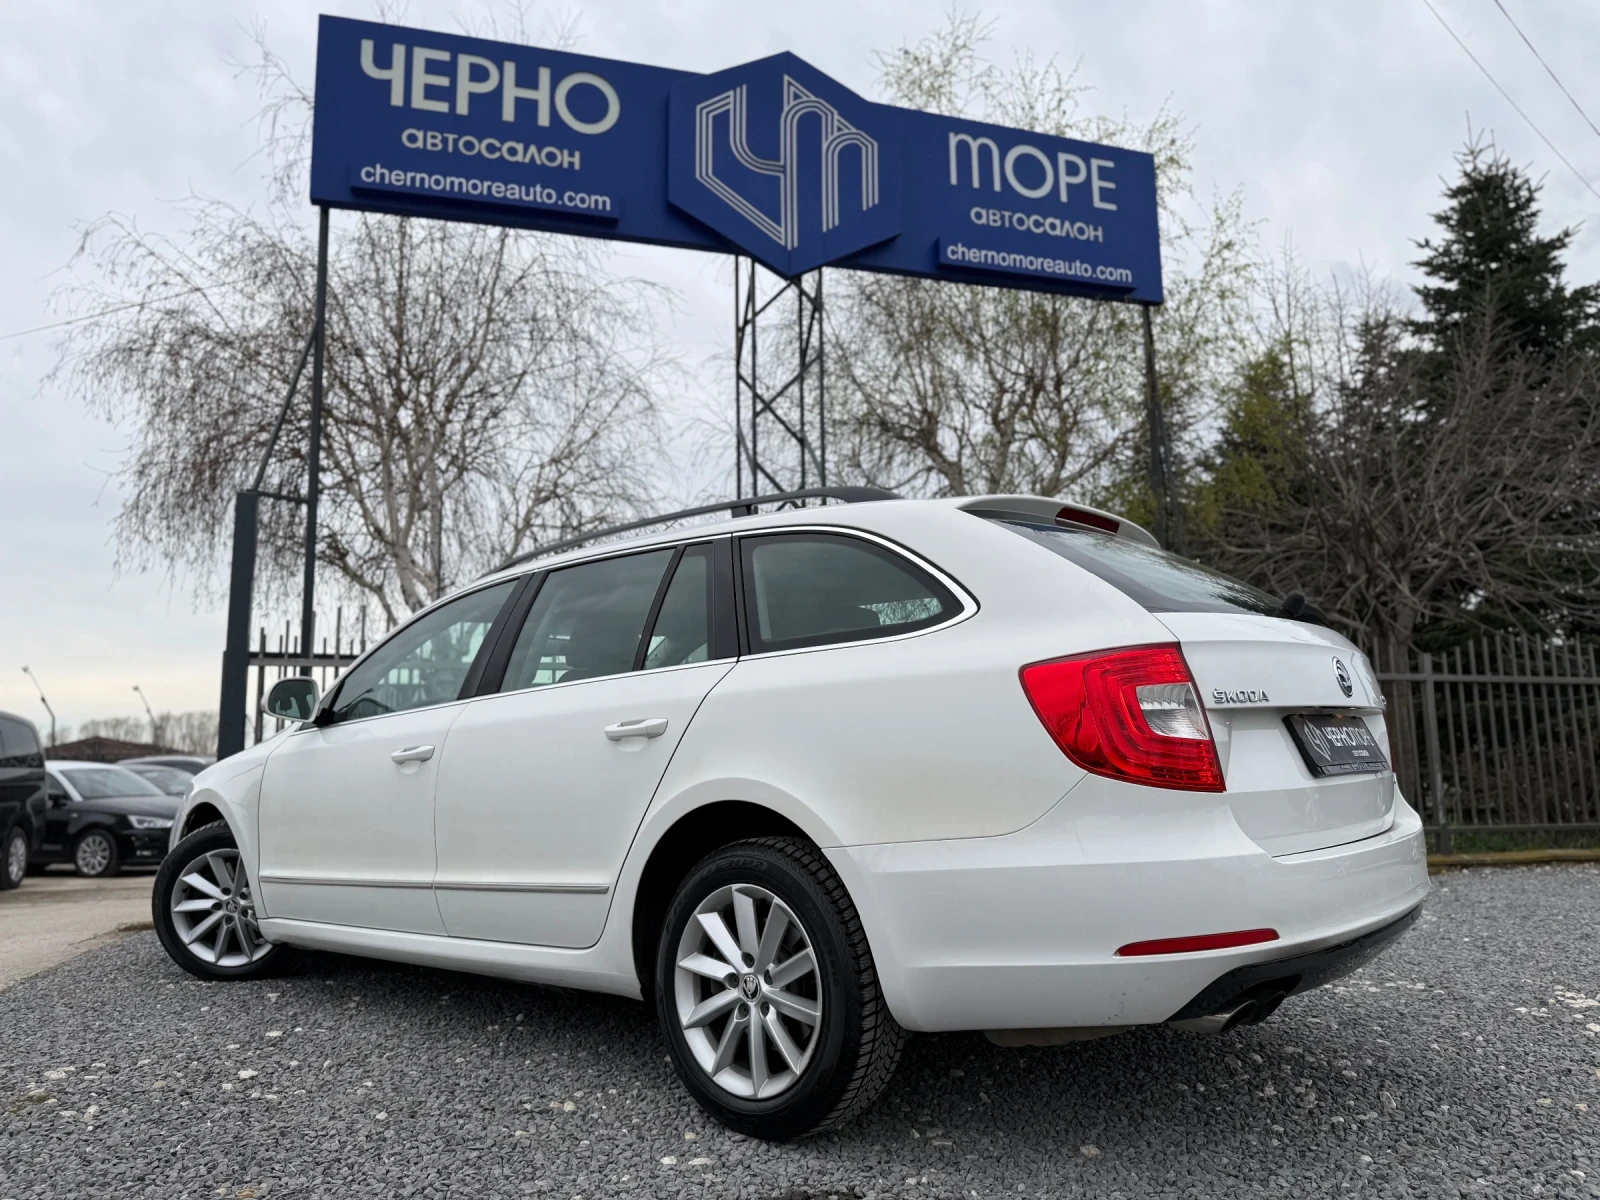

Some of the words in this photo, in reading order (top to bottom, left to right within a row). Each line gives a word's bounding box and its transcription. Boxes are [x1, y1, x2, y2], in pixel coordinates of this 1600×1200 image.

[359, 38, 621, 136] ЧЕРНО
[360, 163, 612, 212] chernomoreauto.com
[947, 243, 1133, 283] chernomoreauto.com
